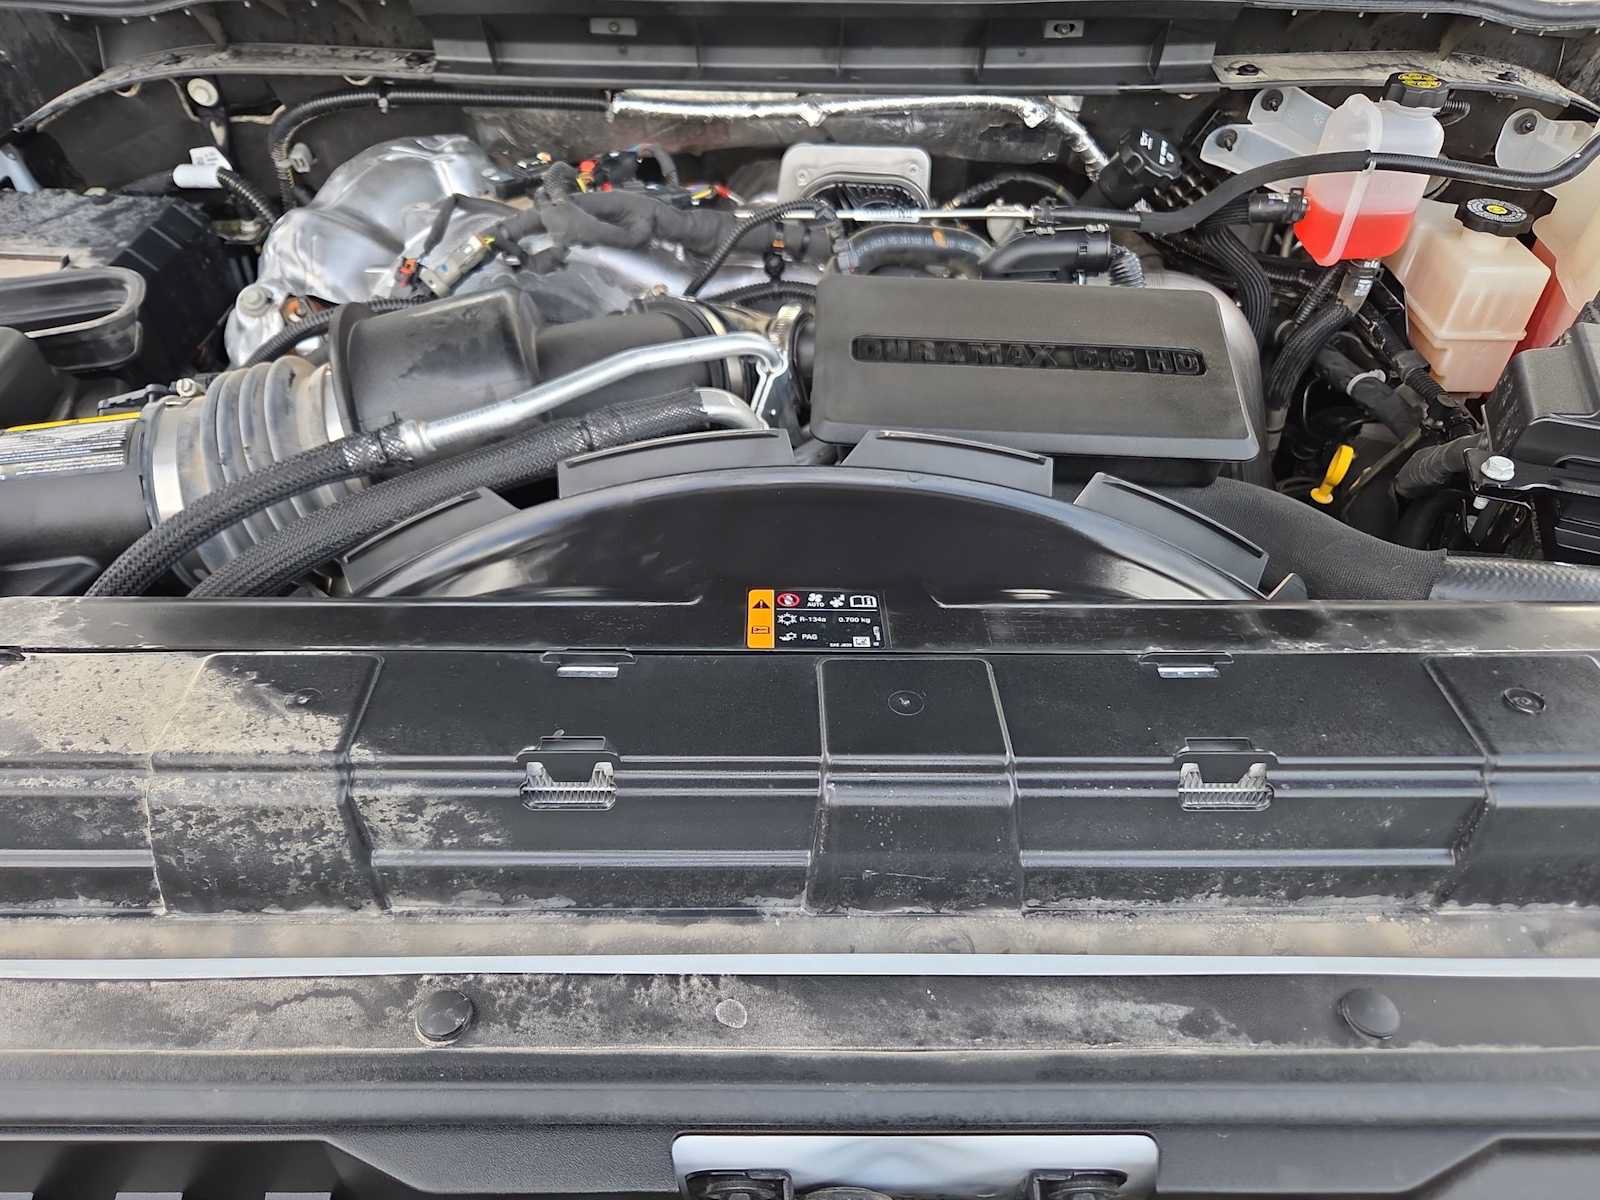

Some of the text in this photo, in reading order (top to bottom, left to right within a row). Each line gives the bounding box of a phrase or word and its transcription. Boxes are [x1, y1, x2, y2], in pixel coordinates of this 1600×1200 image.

[857, 339, 1058, 368] DURAMAX
[1145, 348, 1202, 374] HD
[861, 616, 871, 624] kg
